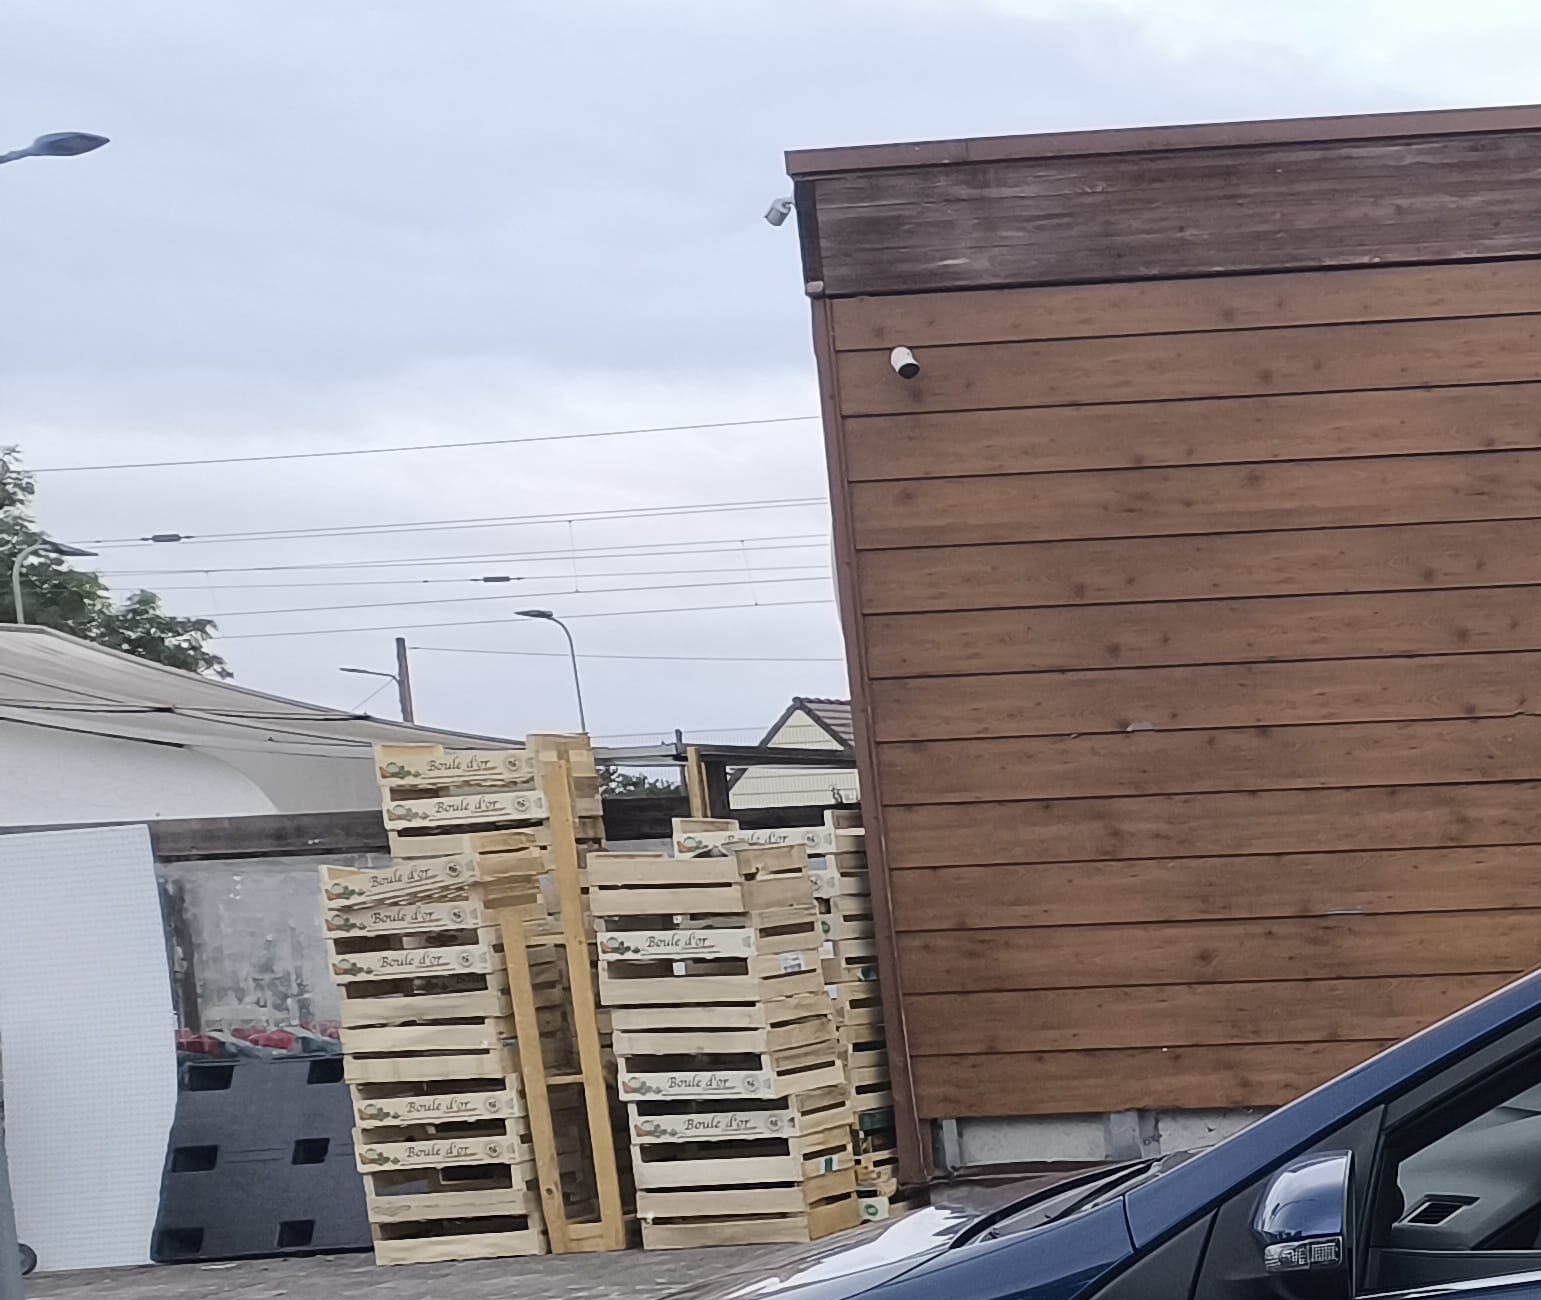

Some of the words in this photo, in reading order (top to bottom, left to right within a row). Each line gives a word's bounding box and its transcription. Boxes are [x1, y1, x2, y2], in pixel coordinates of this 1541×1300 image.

[427, 756, 461, 771] Boule
[466, 755, 491, 769] d'or
[435, 798, 470, 813] Boule
[474, 796, 499, 810] d'or
[370, 872, 402, 888] Boule
[407, 865, 431, 880] d'or
[371, 908, 406, 924] Boule
[410, 906, 435, 920] d'or
[646, 933, 681, 948] Boule
[685, 933, 708, 947] d'or
[378, 953, 414, 968] Boule
[419, 951, 443, 965] d'or
[668, 1074, 701, 1089] Boule
[705, 1074, 730, 1088] d'or
[405, 1099, 441, 1113] Boule
[446, 1098, 470, 1111] d'or
[684, 1117, 720, 1130] Boule
[725, 1113, 750, 1128] d'or
[405, 1143, 441, 1158] Boule
[446, 1142, 470, 1156] d'or
